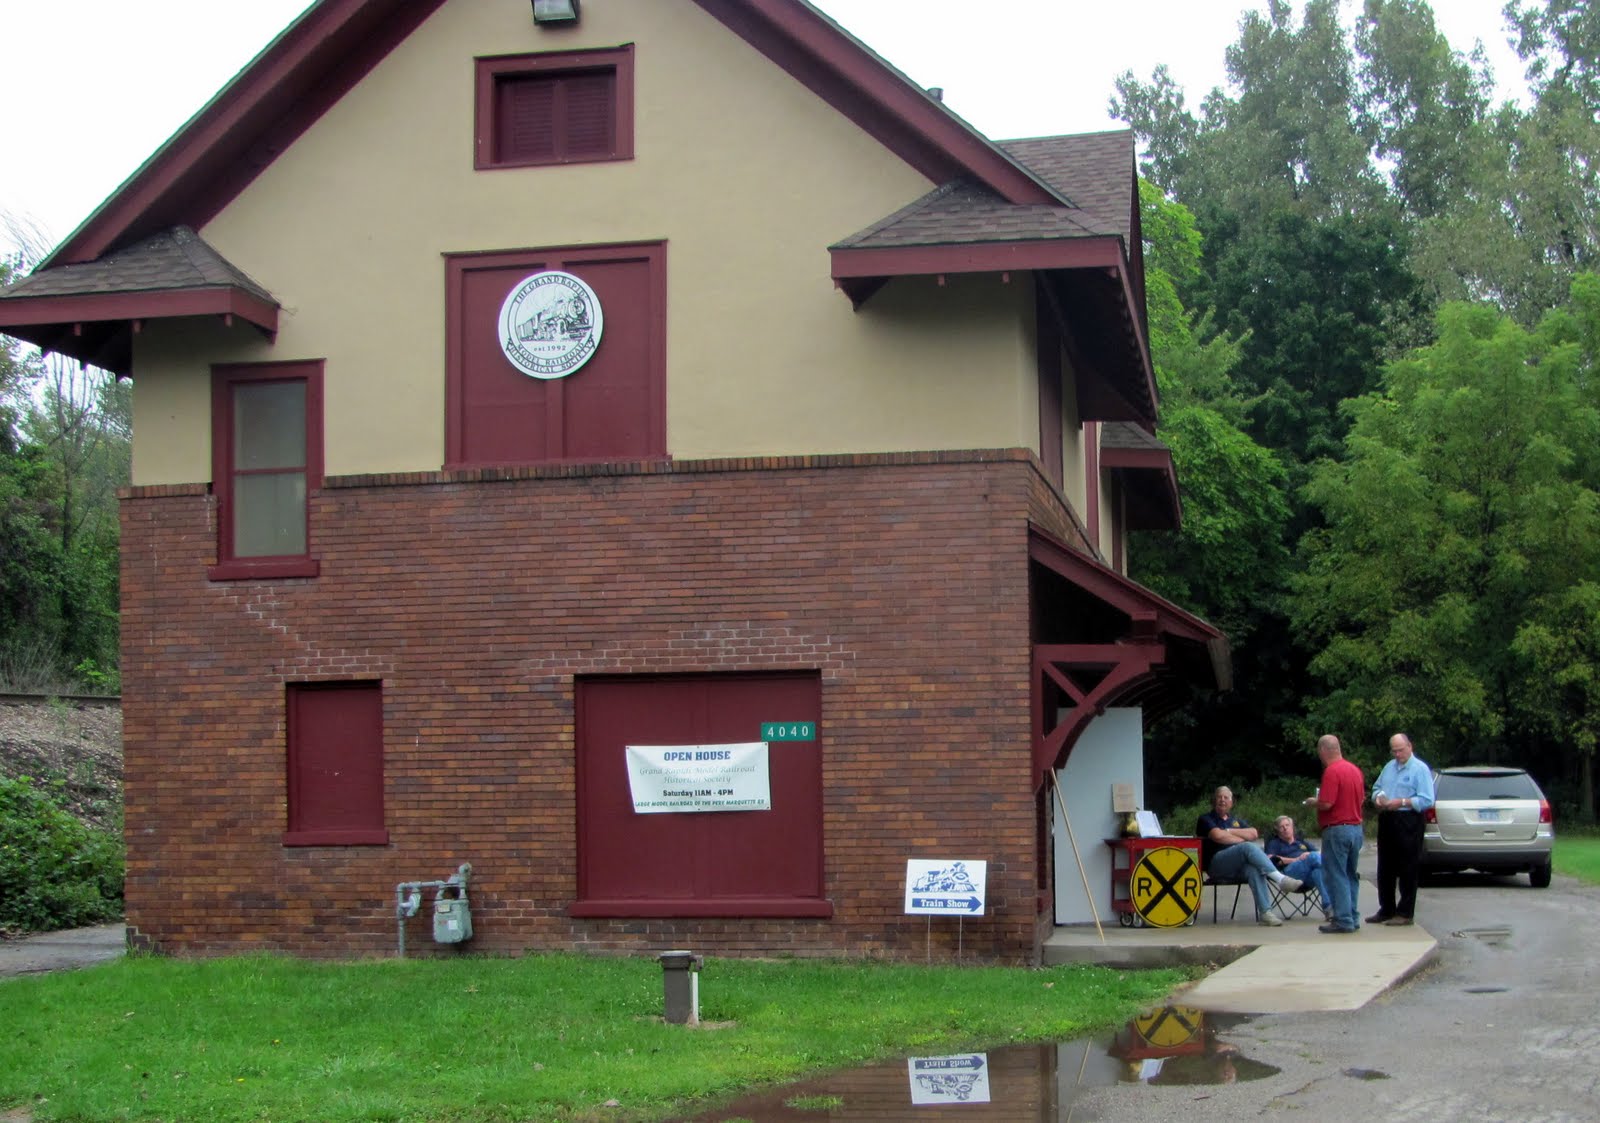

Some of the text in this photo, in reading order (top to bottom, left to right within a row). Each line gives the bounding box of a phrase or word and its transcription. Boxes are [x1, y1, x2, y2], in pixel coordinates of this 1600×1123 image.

[529, 276, 560, 290] GRAND
[545, 342, 586, 366] RAILROAD
[767, 725, 809, 738] 4040
[663, 751, 731, 761] OPEN HOUSE
[639, 767, 663, 776] Grand
[720, 765, 756, 774] Railroad
[704, 775, 731, 785] Society
[662, 789, 693, 798] Saturday
[694, 789, 712, 797] 11AM
[717, 788, 734, 796] 4PM
[1137, 877, 1198, 897] R R
[920, 899, 969, 908] Train Show
